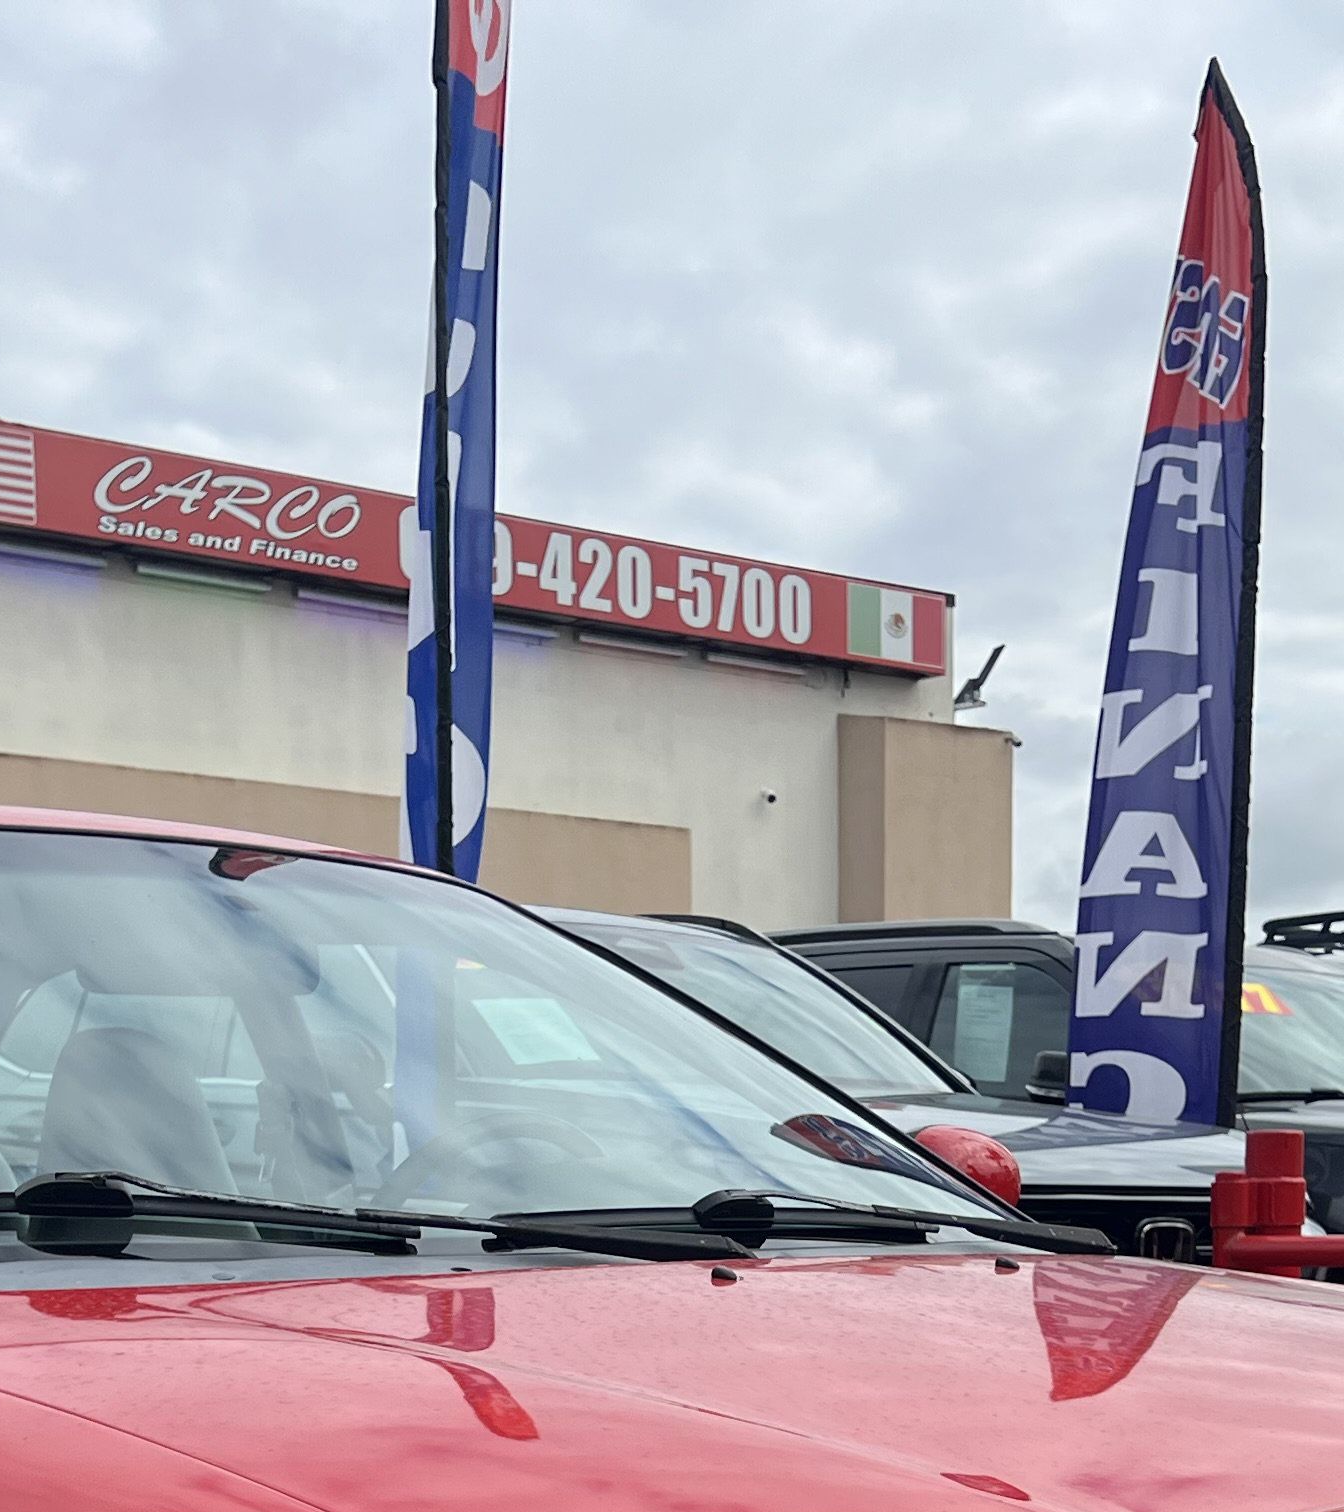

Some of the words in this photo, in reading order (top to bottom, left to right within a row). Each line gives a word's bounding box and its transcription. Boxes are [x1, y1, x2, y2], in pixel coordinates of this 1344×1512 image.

[92, 455, 362, 541] CARCO
[97, 513, 180, 544] Sales
[187, 530, 243, 554] and
[248, 538, 360, 573] Finance
[398, 504, 812, 645] 9-420-5700
